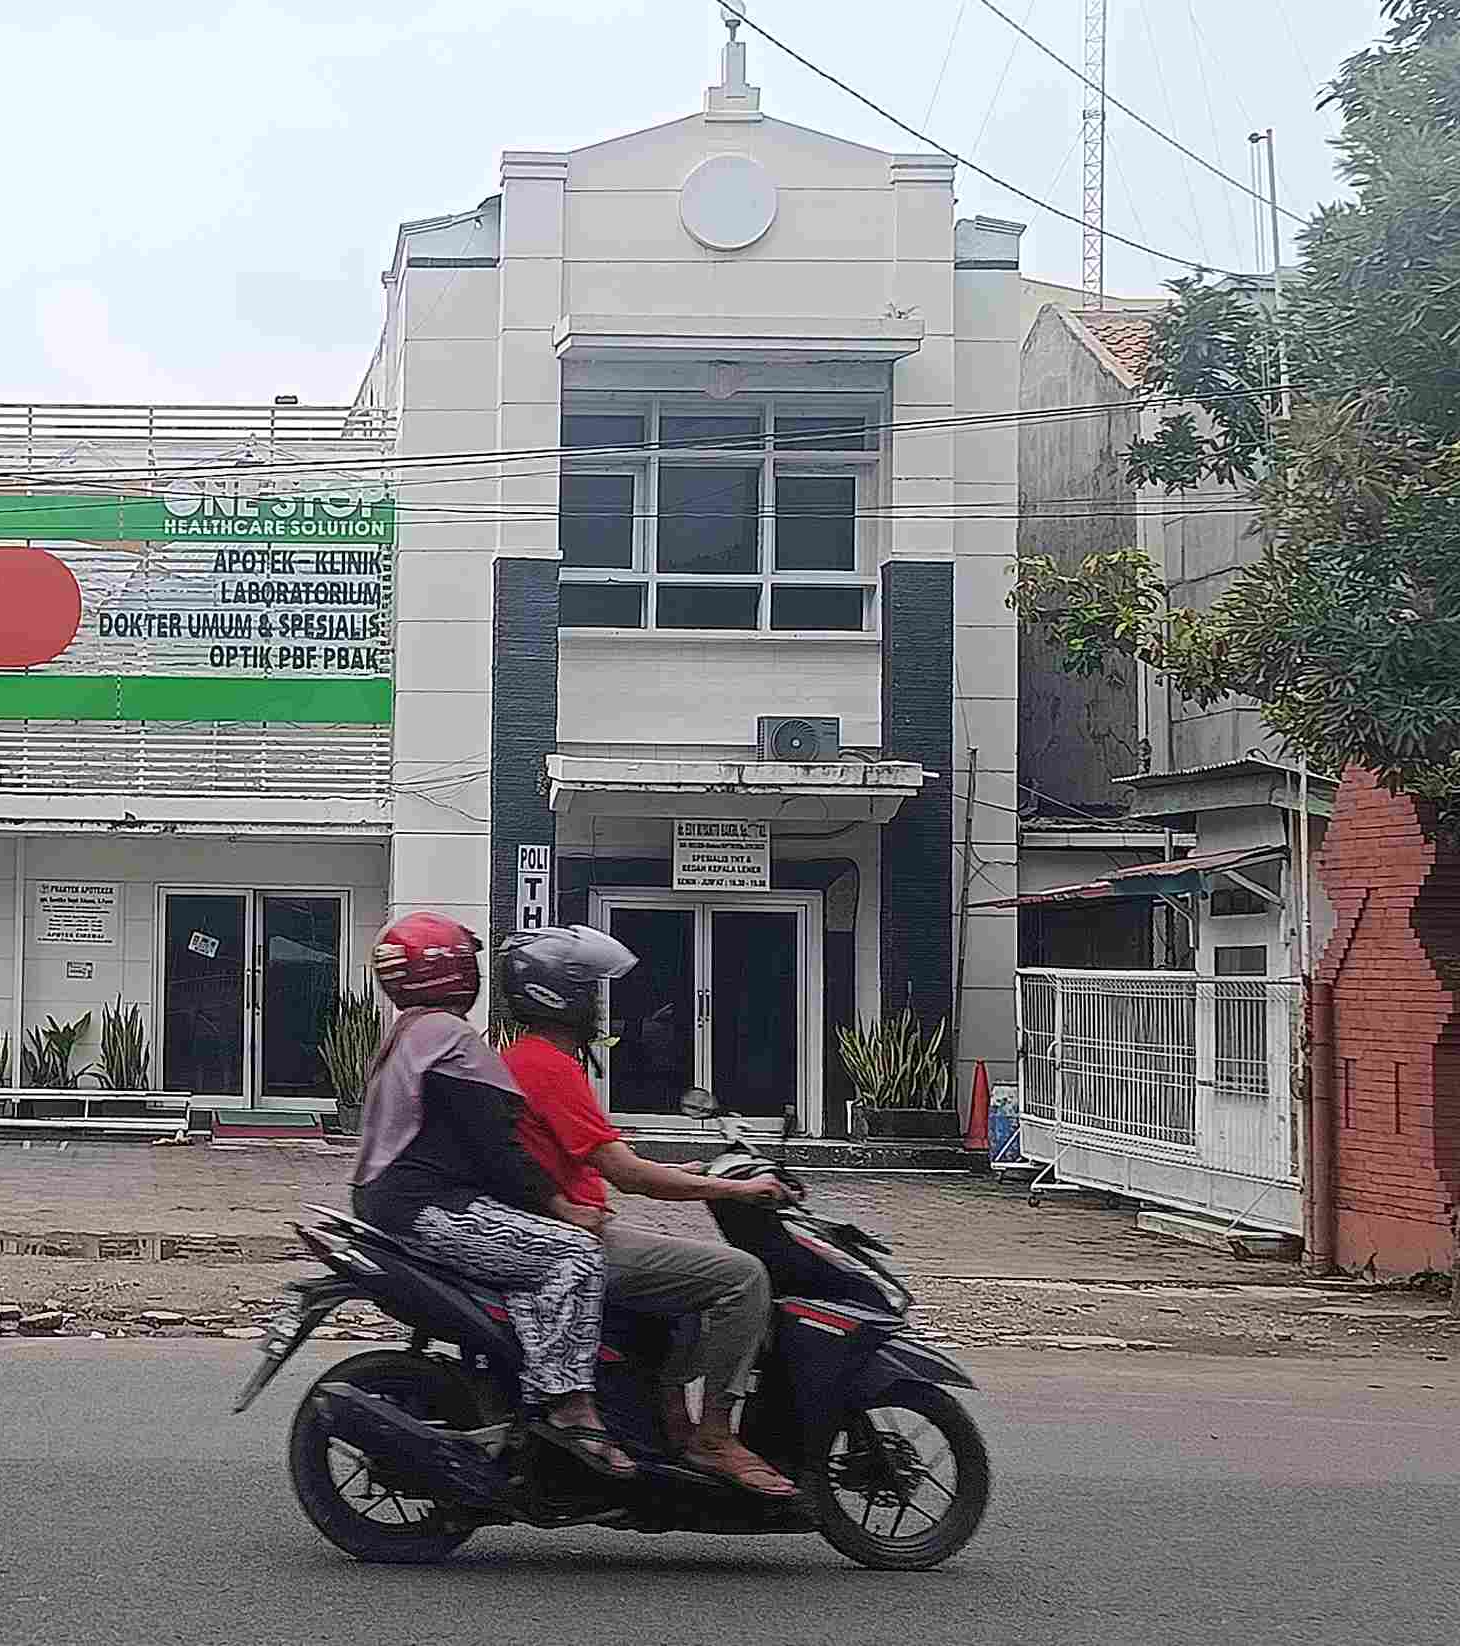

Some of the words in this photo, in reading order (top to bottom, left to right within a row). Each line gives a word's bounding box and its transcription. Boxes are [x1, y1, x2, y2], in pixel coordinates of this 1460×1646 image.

[164, 481, 261, 517] ONE
[271, 482, 388, 518] STOP
[164, 520, 286, 535] HEALTHCARE
[291, 521, 385, 536] SOLUTION
[213, 551, 295, 574] APOTEK
[316, 552, 382, 574] KLINIK
[221, 582, 381, 604] LABORATORIUM
[100, 613, 181, 638] DOKTER
[189, 614, 252, 638] UMUM
[258, 614, 273, 638] &
[279, 614, 381, 640] SPESIALIS
[209, 646, 272, 668] OPTIK
[520, 848, 548, 870] POLI
